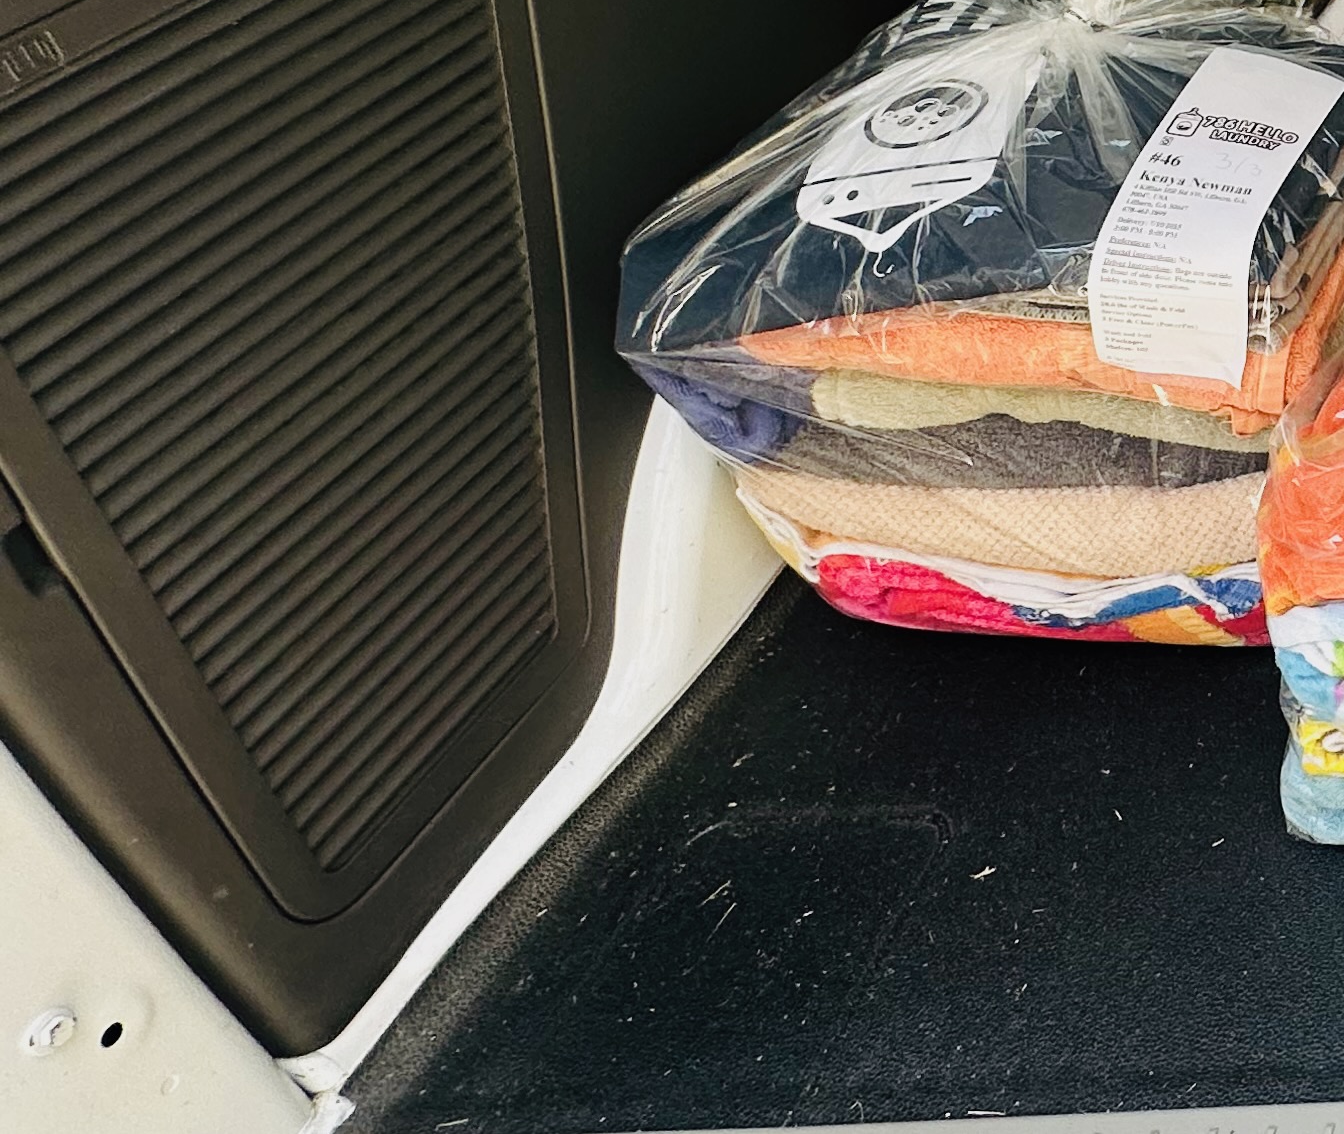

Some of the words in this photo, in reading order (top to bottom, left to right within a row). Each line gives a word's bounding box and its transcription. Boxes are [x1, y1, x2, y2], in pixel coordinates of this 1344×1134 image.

[1202, 115, 1238, 131] 786
[1237, 120, 1299, 144] HELLO
[1209, 129, 1282, 150] LAUNDRY
[1149, 152, 1184, 167] #46
[1140, 170, 1185, 186] Kenya
[1192, 177, 1252, 195] Newman
